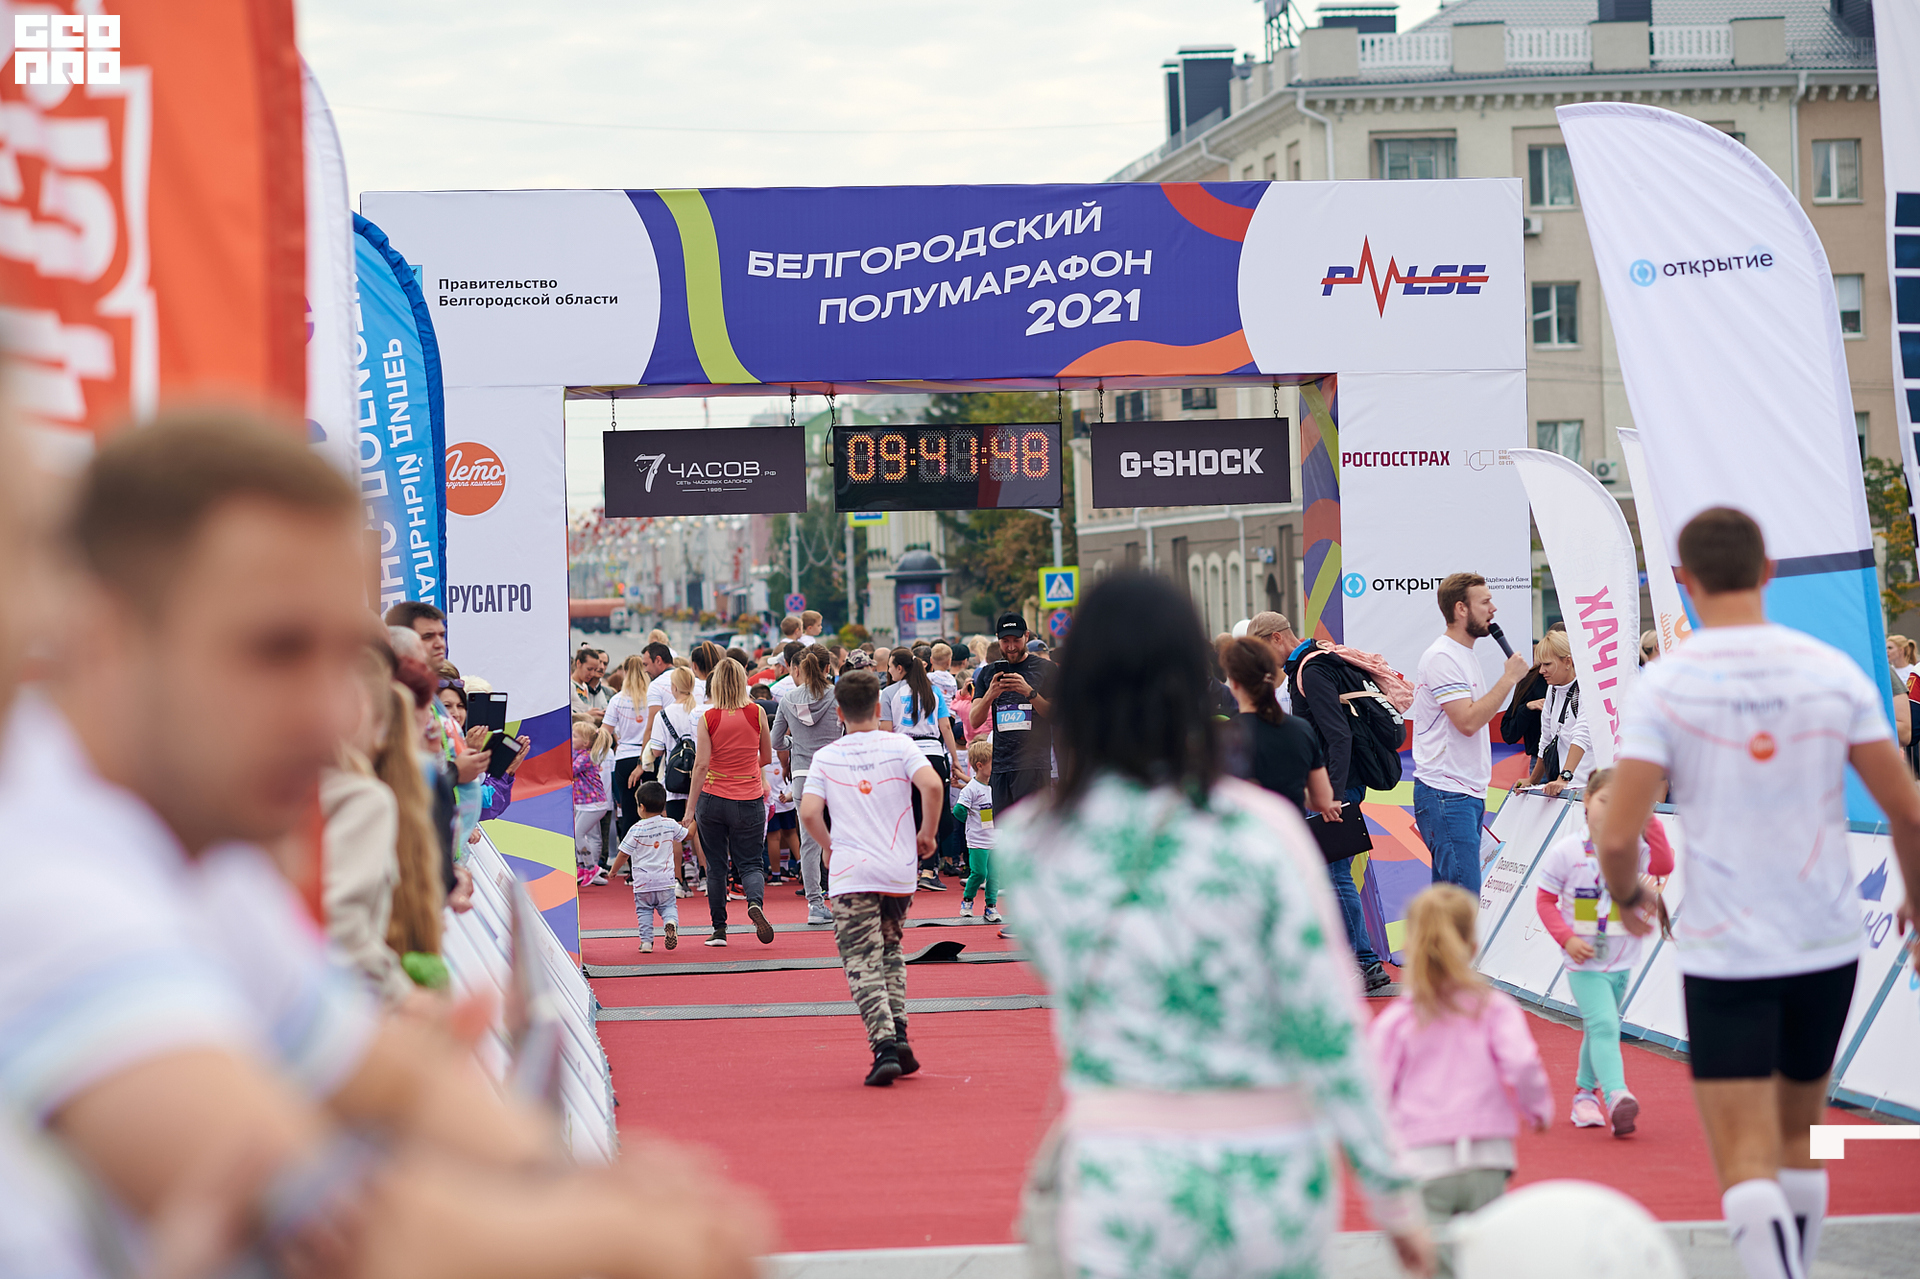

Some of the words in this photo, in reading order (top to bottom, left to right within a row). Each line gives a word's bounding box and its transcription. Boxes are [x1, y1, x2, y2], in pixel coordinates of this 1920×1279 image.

[747, 200, 1102, 280] БЕЛГОРОДСКИЙ
[1663, 253, 1773, 278] открытие
[438, 278, 558, 292] Правительство
[818, 249, 1153, 325] ПОЛУМАРАФОН
[438, 293, 550, 309] Белгородской
[555, 294, 619, 305] области
[1025, 288, 1141, 336] 2021
[847, 431, 1050, 483] 09:41:48
[1119, 447, 1264, 478] G-SHOCK
[1341, 450, 1451, 467] РОСГОССТРАХ
[448, 583, 532, 613] РУСАГРО
[1372, 578, 1445, 595] открыт
[1001, 711, 1023, 723] 1047
